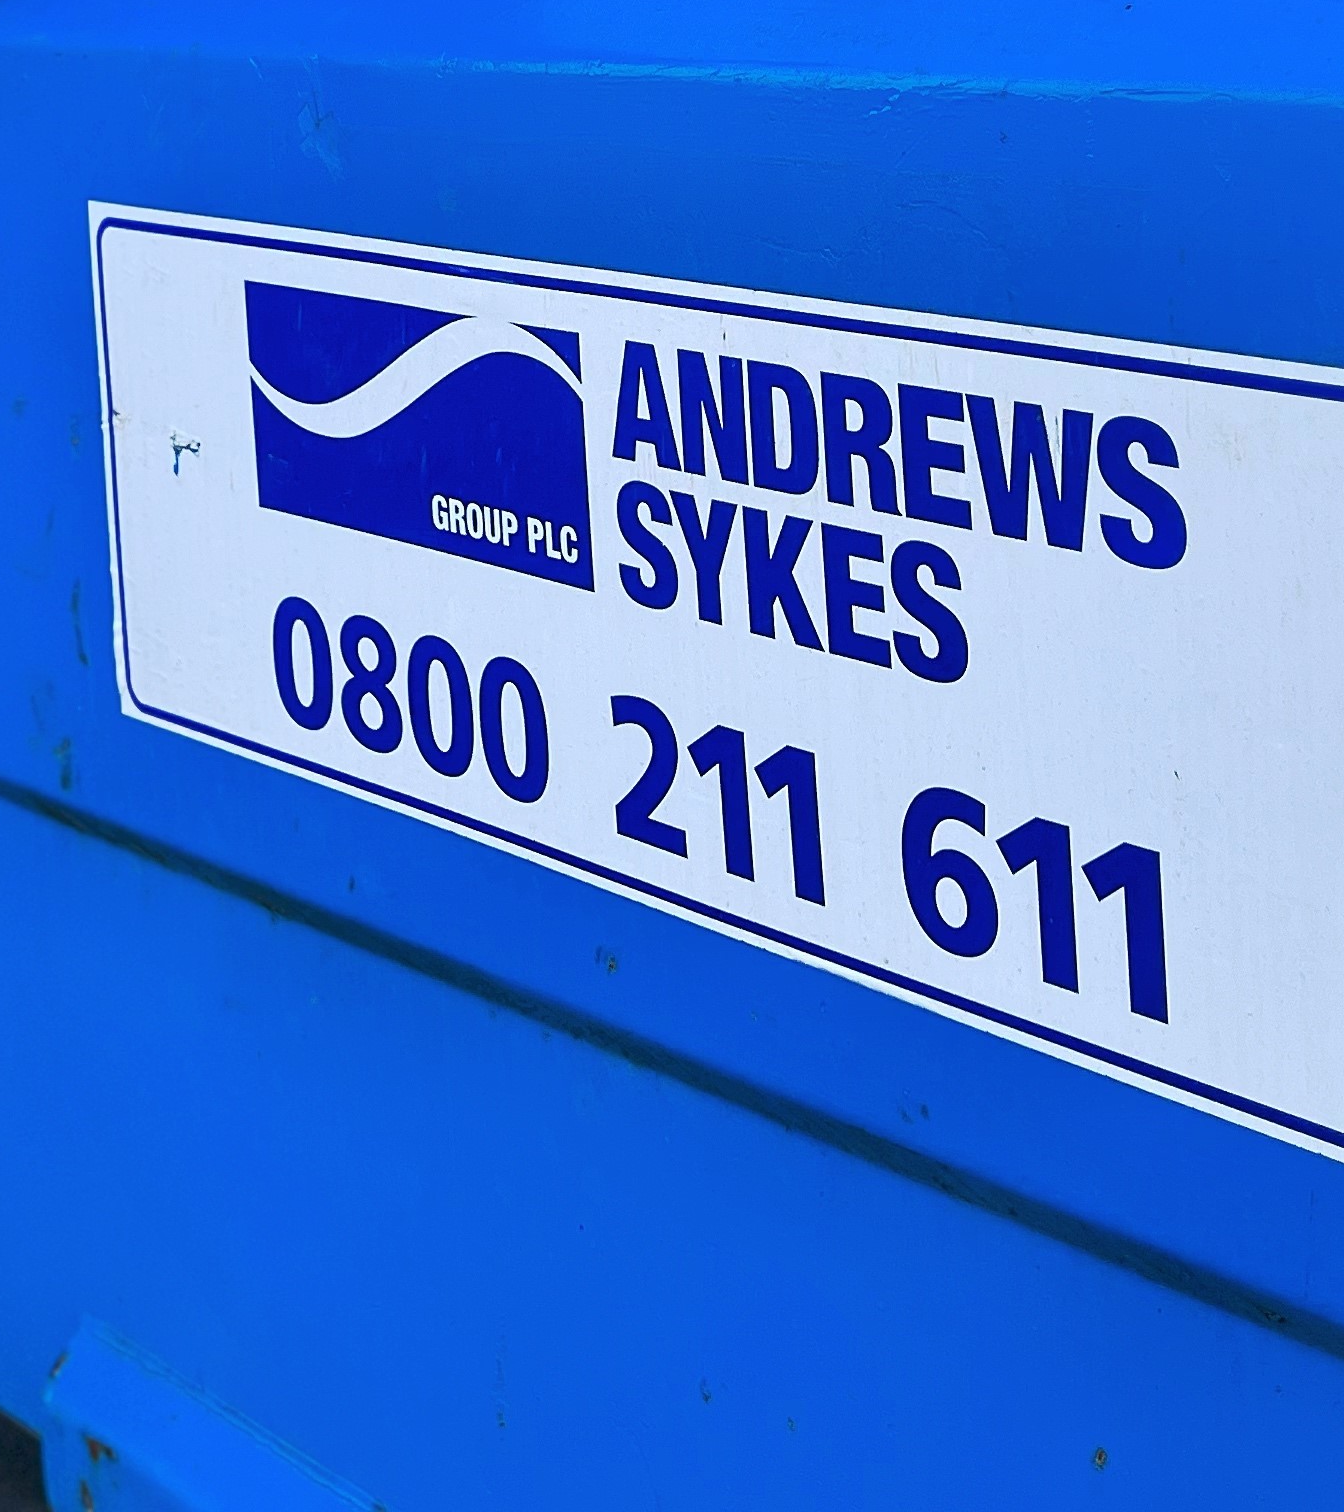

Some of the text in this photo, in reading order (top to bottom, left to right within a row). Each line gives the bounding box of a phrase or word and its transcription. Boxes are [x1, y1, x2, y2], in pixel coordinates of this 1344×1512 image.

[431, 494, 579, 564] GROUP PLC
[610, 338, 1189, 571] ANDREWS
[615, 479, 970, 685] SYKES
[271, 595, 1170, 1026] 0800 211 611
